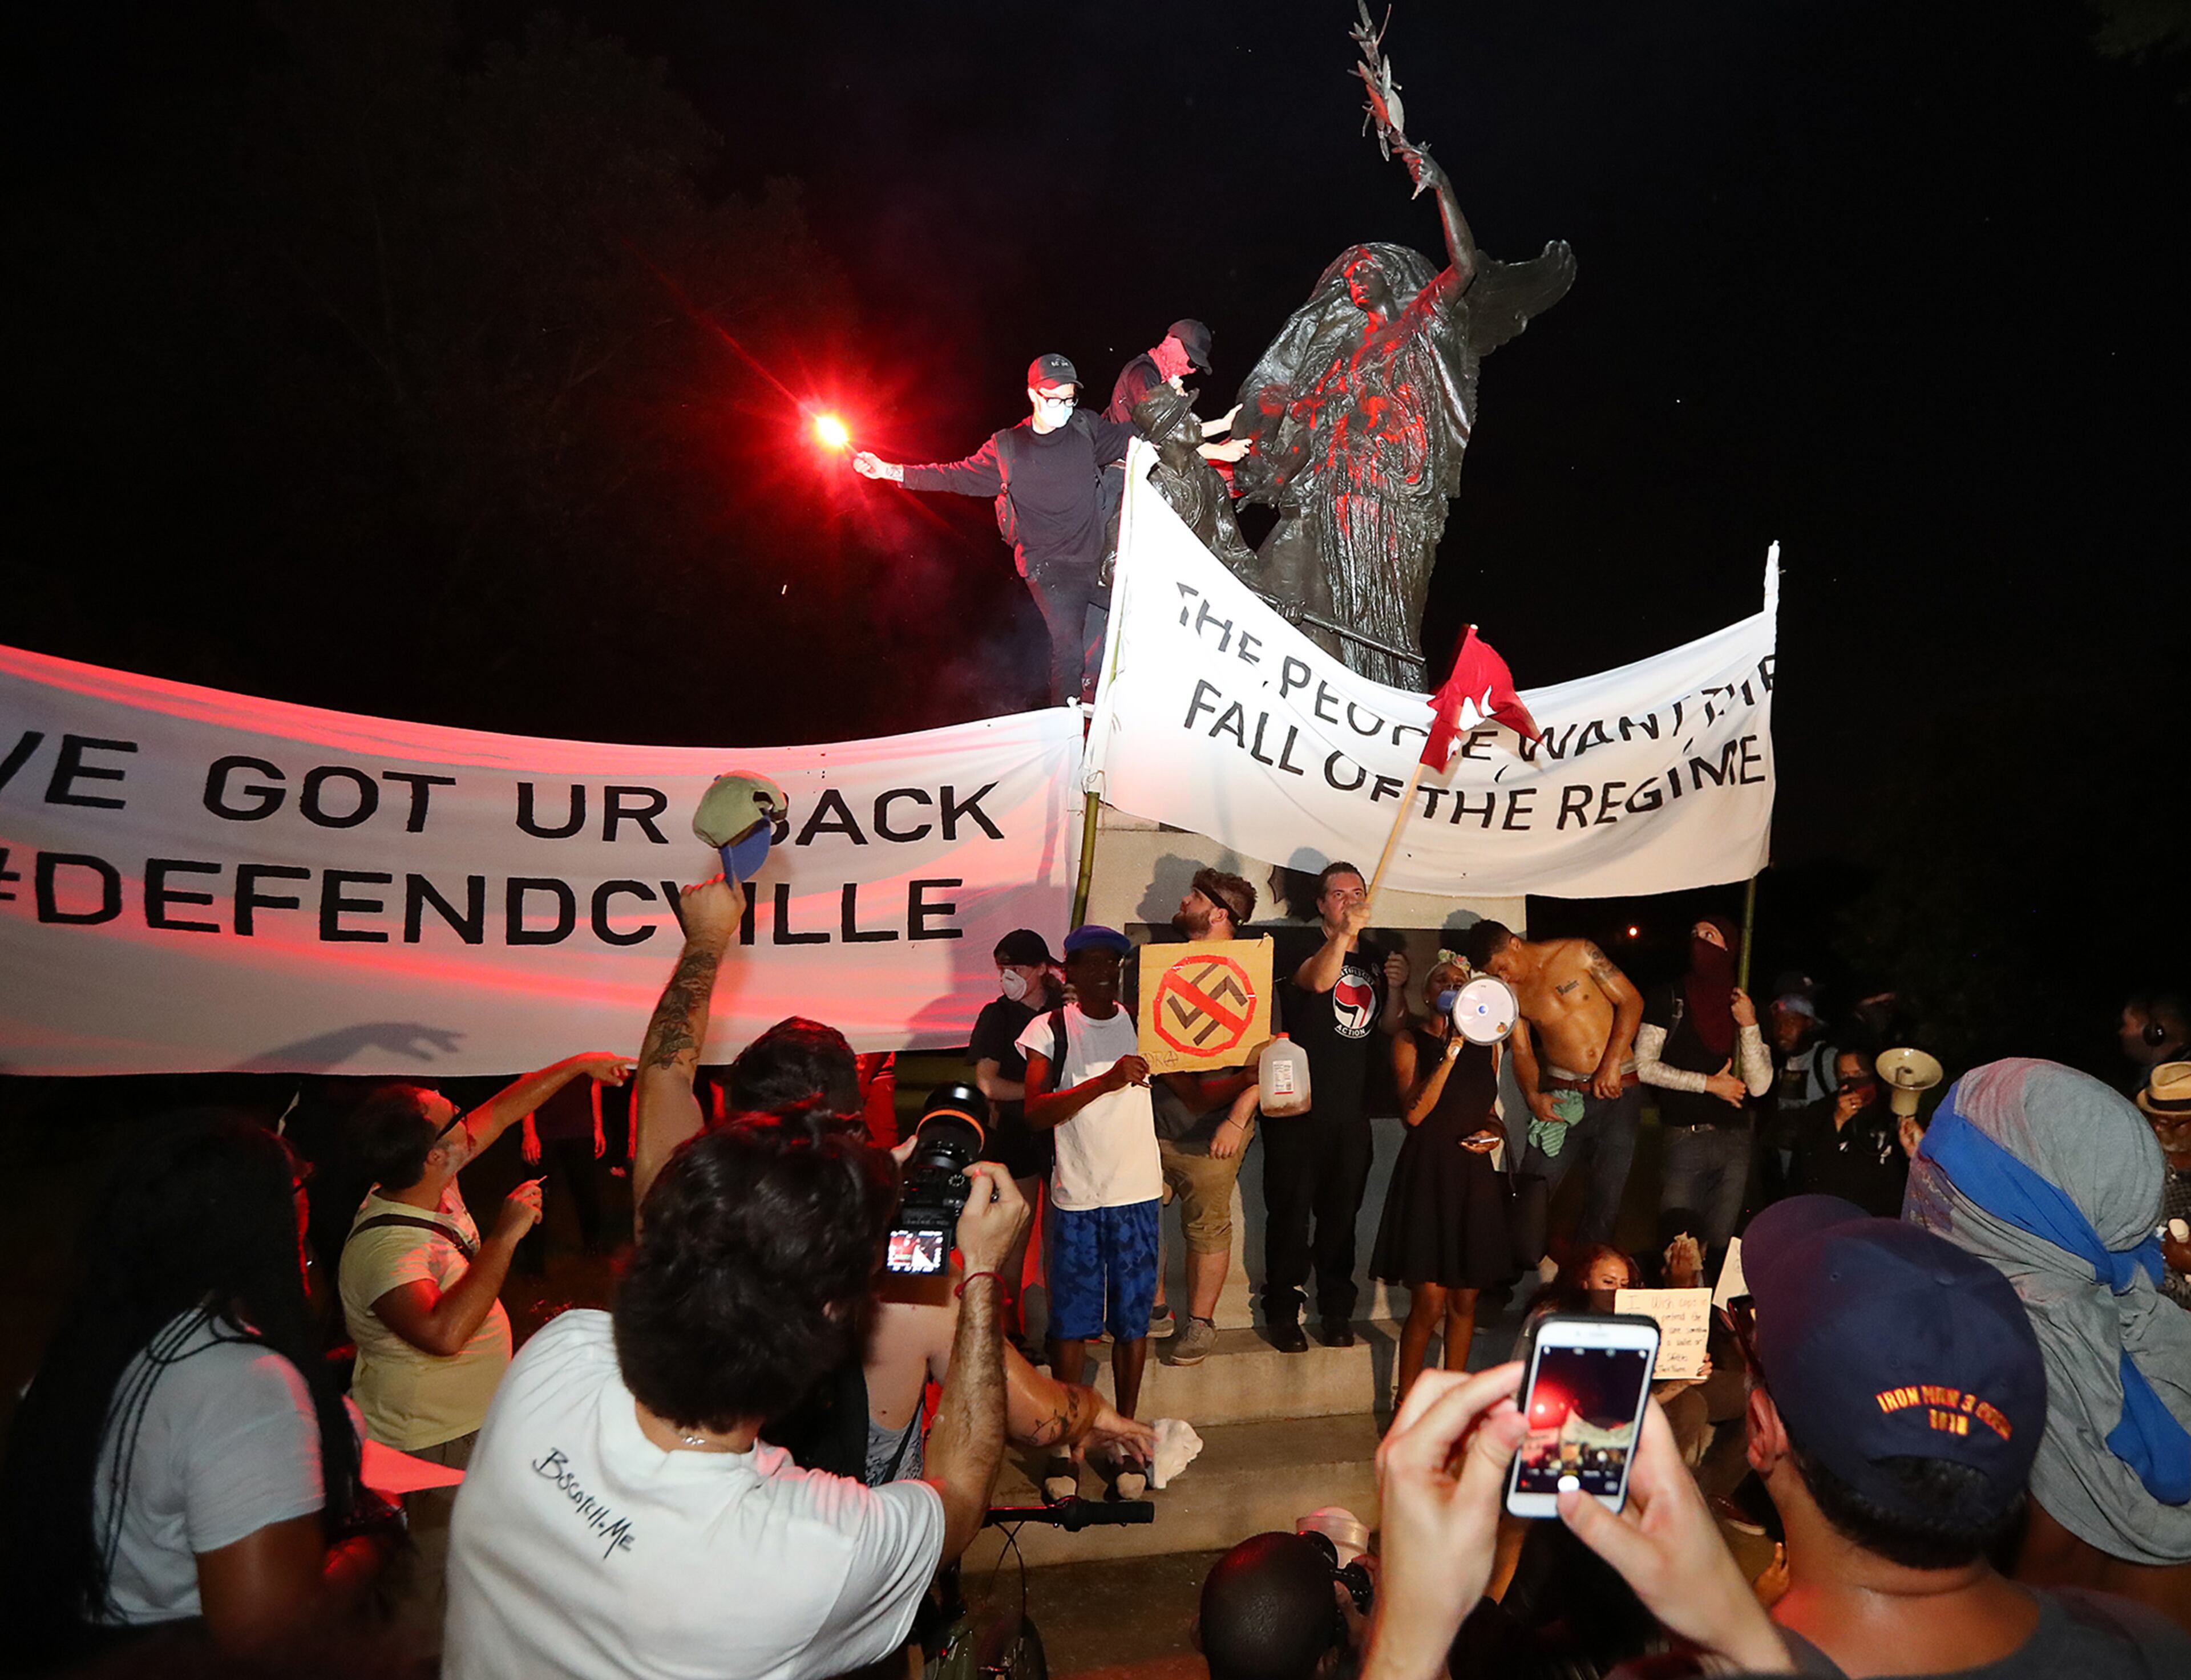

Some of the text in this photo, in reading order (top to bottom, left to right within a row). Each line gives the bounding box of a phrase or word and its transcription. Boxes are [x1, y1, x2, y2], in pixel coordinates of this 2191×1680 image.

[1176, 581, 1262, 666] THE
[1280, 655, 1498, 761] PEOPE
[1184, 678, 1765, 831] FALL OF THE REGIME
[202, 755, 457, 833] GOT
[516, 782, 669, 845] UR
[759, 781, 1005, 846] ACK
[1336, 1025, 1366, 1036] ACTION
[1875, 1385, 1921, 1414] IRON
